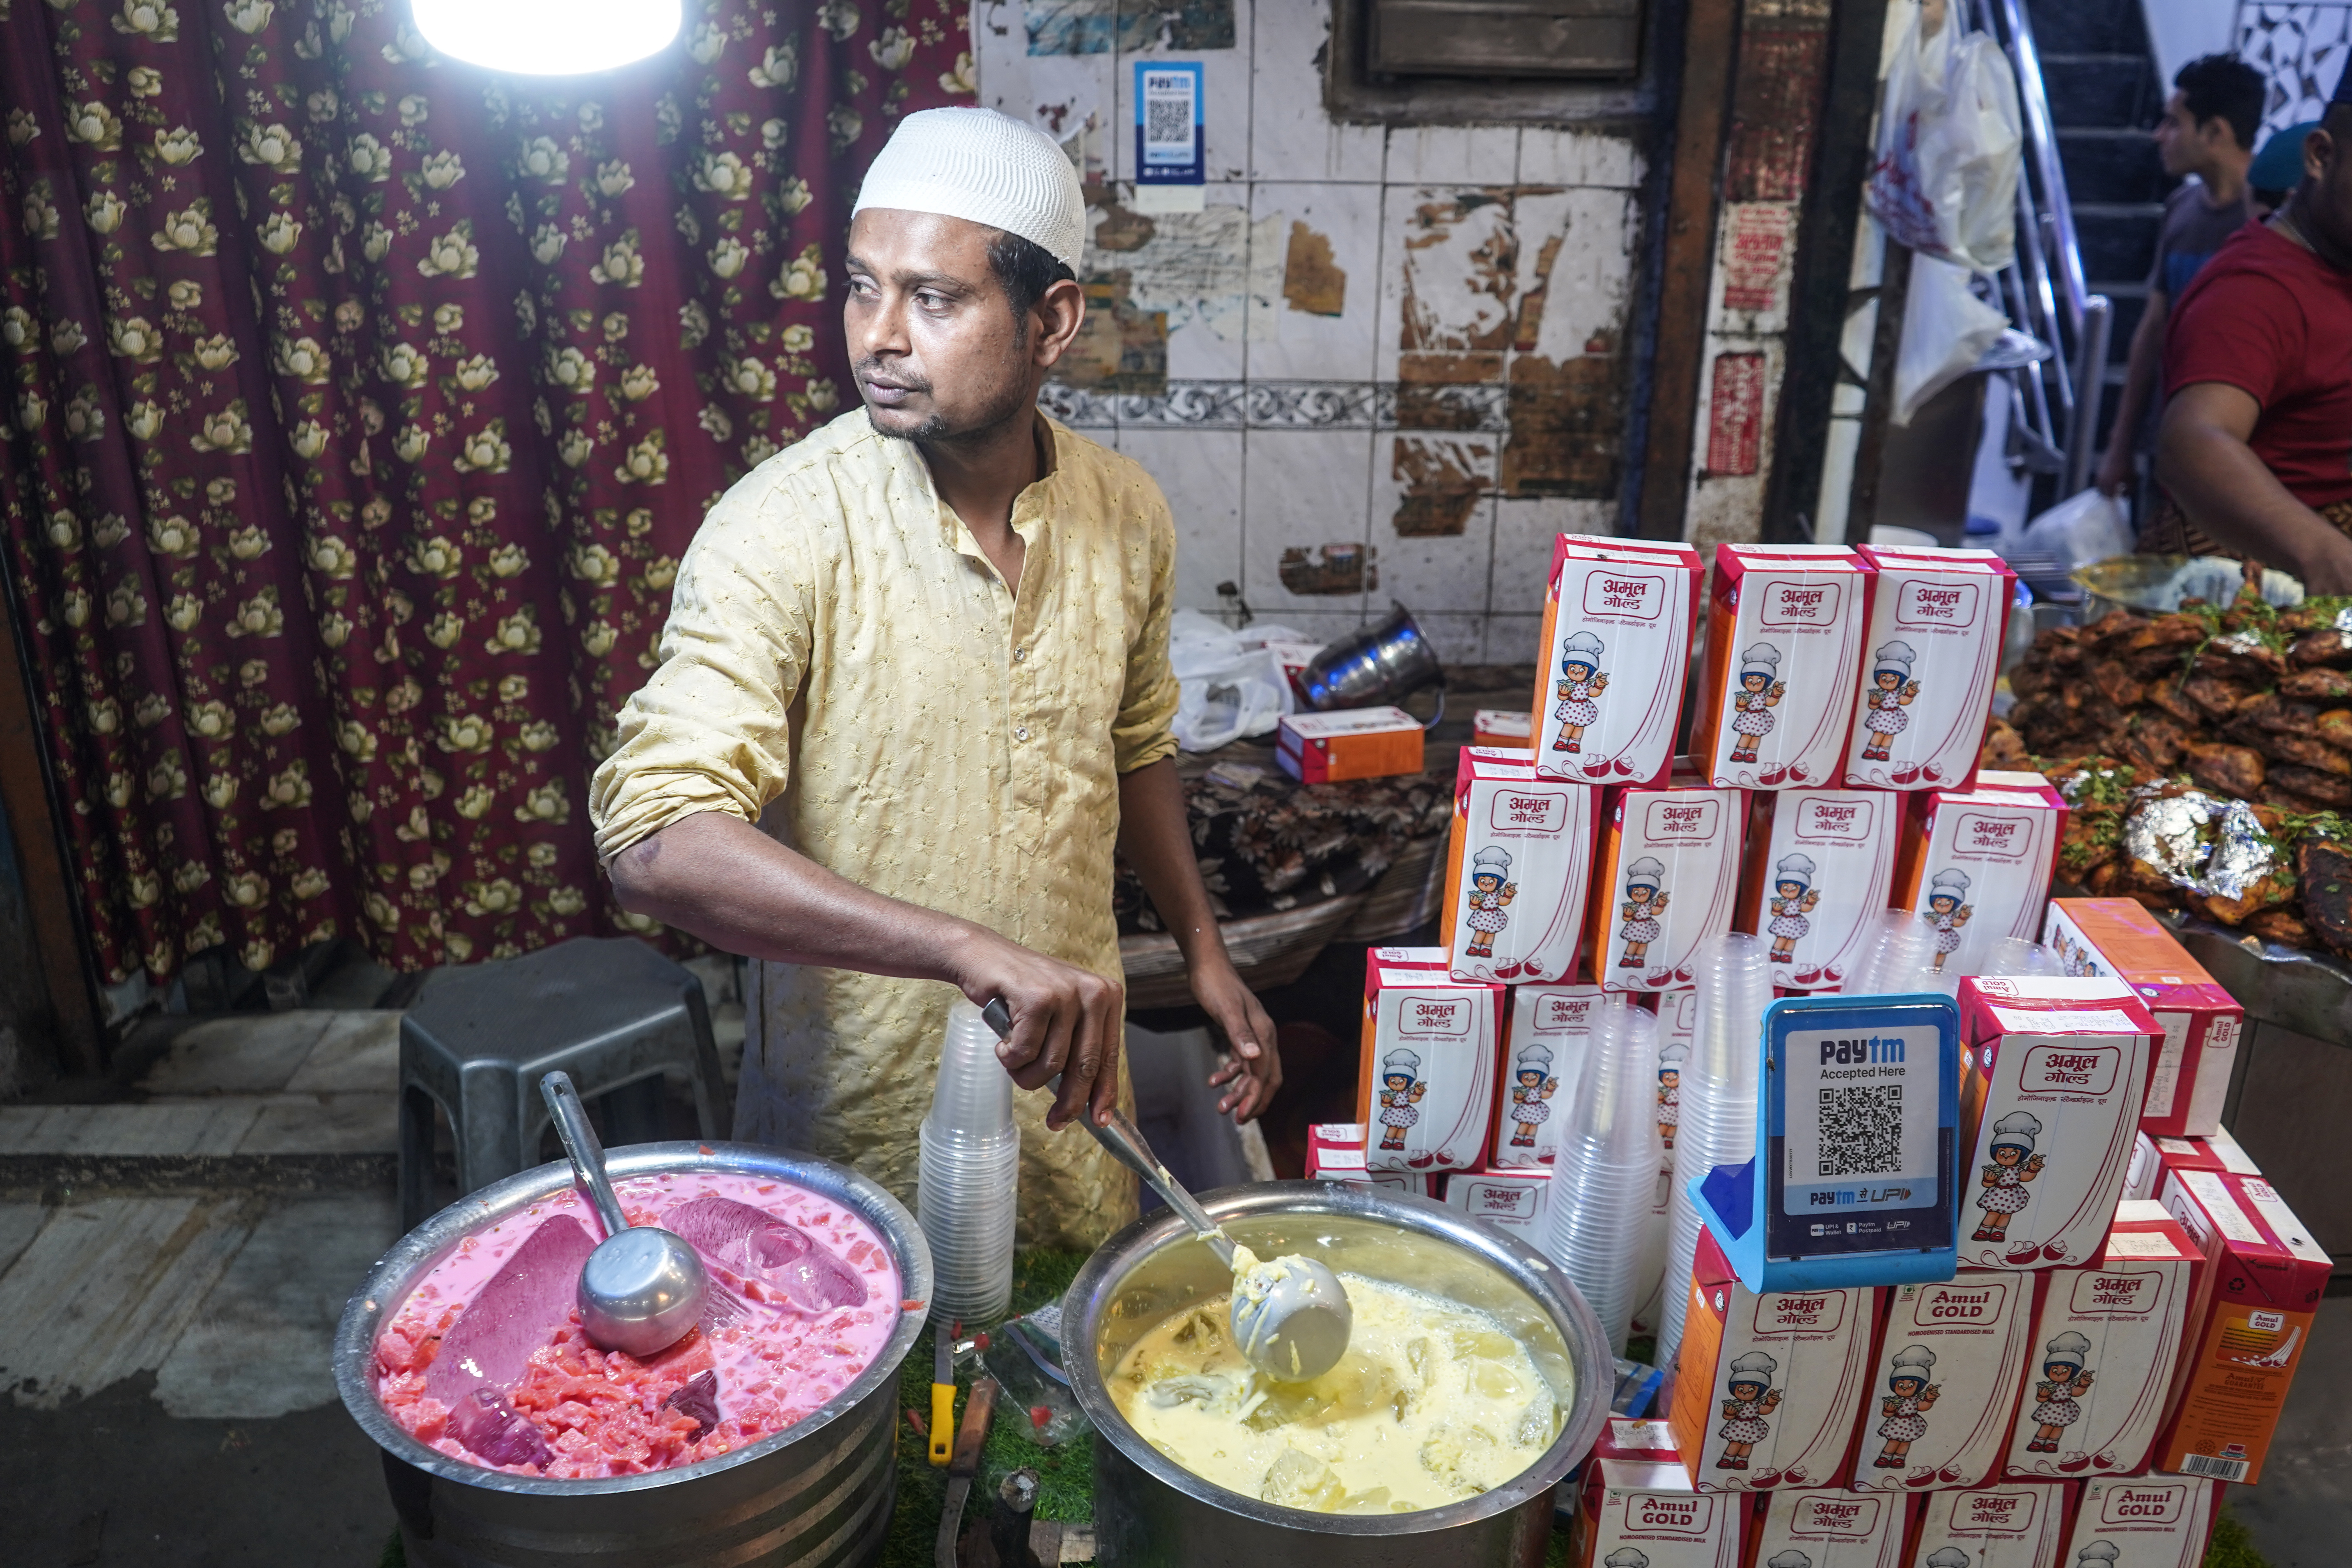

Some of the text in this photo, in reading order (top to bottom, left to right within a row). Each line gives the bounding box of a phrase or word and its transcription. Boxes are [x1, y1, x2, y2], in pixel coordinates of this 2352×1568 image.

[1603, 579, 1648, 597] अमूल
[1604, 595, 1643, 610] गोल्ड
[1781, 590, 1824, 606] अमूल
[1917, 588, 1962, 606] अमूल
[1781, 604, 1818, 617] गोल्ड
[1917, 604, 1956, 618] गोल्ड
[1509, 797, 1551, 813] अमूल
[1510, 811, 1547, 823] गोल्ड
[1663, 807, 1704, 822] अमूल
[1815, 806, 1857, 821] अमूल
[1664, 820, 1698, 832] गोल्ड
[1815, 819, 1852, 832] गोल्ड
[1973, 821, 2017, 837] अमूल
[1973, 835, 2010, 848] गोल्ड
[1416, 1004, 1457, 1018] अमूल
[1551, 1001, 1591, 1014] अमूल
[1417, 1016, 1453, 1028] गोल्ड
[1552, 1012, 1586, 1022] गोल्ड
[2221, 1022, 2231, 1042] GOLD
[2045, 1054, 2101, 1072] अमूल
[1820, 1067, 1905, 1081] Accepted Here
[2044, 1069, 2092, 1085] गोल्ड
[1483, 1189, 1521, 1203] अमूल
[1870, 1188, 1906, 1202] UPI
[1484, 1200, 1517, 1211] गोल्ड
[2093, 1277, 2144, 1294] अमूल
[1931, 1291, 1991, 1304] Amul
[2093, 1292, 2136, 1305] गोल्ड
[1776, 1298, 1827, 1313] अमूल
[1932, 1306, 1983, 1317] GOLD
[1777, 1312, 1820, 1324] गोल्ड
[2256, 1314, 2279, 1322] Amul
[2118, 1490, 2172, 1503] Amul
[1641, 1498, 1698, 1513] Amul
[1813, 1503, 1863, 1518] अमूल
[1971, 1498, 2019, 1513] अमूल
[2118, 1505, 2165, 1516] GOLD
[1643, 1513, 1693, 1525] GOLD
[1813, 1515, 1855, 1528] गोल्ड
[1971, 1510, 2012, 1523] गोल्ड
